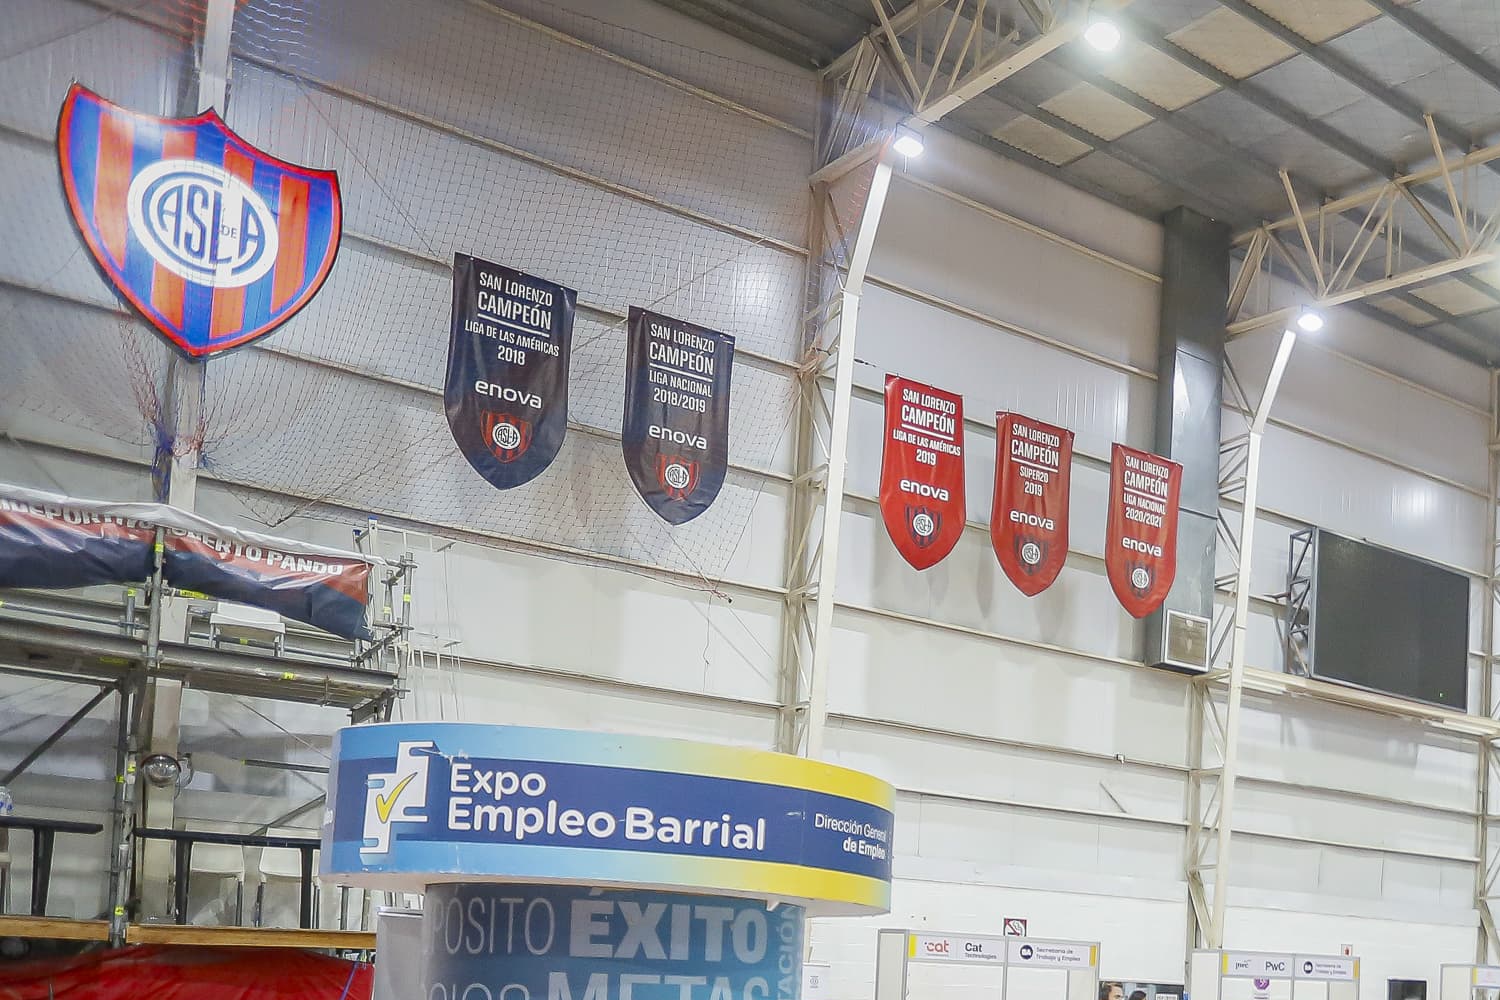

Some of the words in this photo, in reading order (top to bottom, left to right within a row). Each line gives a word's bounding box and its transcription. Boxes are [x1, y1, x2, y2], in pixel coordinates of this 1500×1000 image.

[480, 271, 502, 291] SAN
[505, 280, 552, 306] LORENZO
[478, 291, 551, 330] CAMPEÓN
[465, 320, 484, 335] LIGA
[486, 325, 497, 339] DE
[499, 329, 515, 343] LAS
[515, 335, 559, 357] AMÉRICAS
[650, 323, 670, 340] SAN
[673, 330, 715, 353] LORENZO
[497, 345, 525, 366] 2018
[649, 342, 714, 375] CAMPEÓN
[475, 380, 542, 409] enova
[649, 370, 668, 385] LIGA
[670, 376, 712, 397] NACIONAL
[653, 388, 706, 413] 2018/2019
[903, 389, 919, 404] SAN
[921, 394, 955, 414] LORENZO
[902, 405, 955, 434] CAMPEÓN
[648, 425, 707, 449] enova
[893, 429, 907, 442] LIGA
[908, 433, 916, 444] DE
[917, 436, 929, 448] LAS
[929, 440, 961, 456] AMÉRICAS
[1012, 423, 1027, 438] SAN
[1029, 428, 1059, 447] LORENZO
[916, 449, 936, 466] 2019
[1011, 439, 1059, 467] CAMPEÓN
[1020, 466, 1048, 483] SUPER20
[1125, 455, 1139, 470] SAN
[1140, 460, 1169, 479] LORENZO
[900, 479, 949, 501] enova
[1024, 481, 1042, 497] 2019
[1124, 470, 1167, 497] CAMPEÓN
[1123, 493, 1136, 506] LIGA
[1137, 498, 1166, 515] NACIONAL
[1010, 510, 1054, 531] enova
[1125, 507, 1162, 528] 2020/2021
[1122, 537, 1162, 557] enova
[266, 552, 344, 576] PANDO
[450, 762, 547, 799] Expo
[447, 796, 617, 842] Empleo
[623, 805, 766, 850] Barrial
[815, 813, 862, 835] Dirección
[864, 823, 887, 842] General
[843, 837, 857, 852] de
[858, 839, 885, 860] Empleo
[568, 887, 768, 964] ÉXITO
[926, 940, 949, 953] cat
[964, 942, 982, 953] Cat
[1265, 961, 1285, 972] PwC
